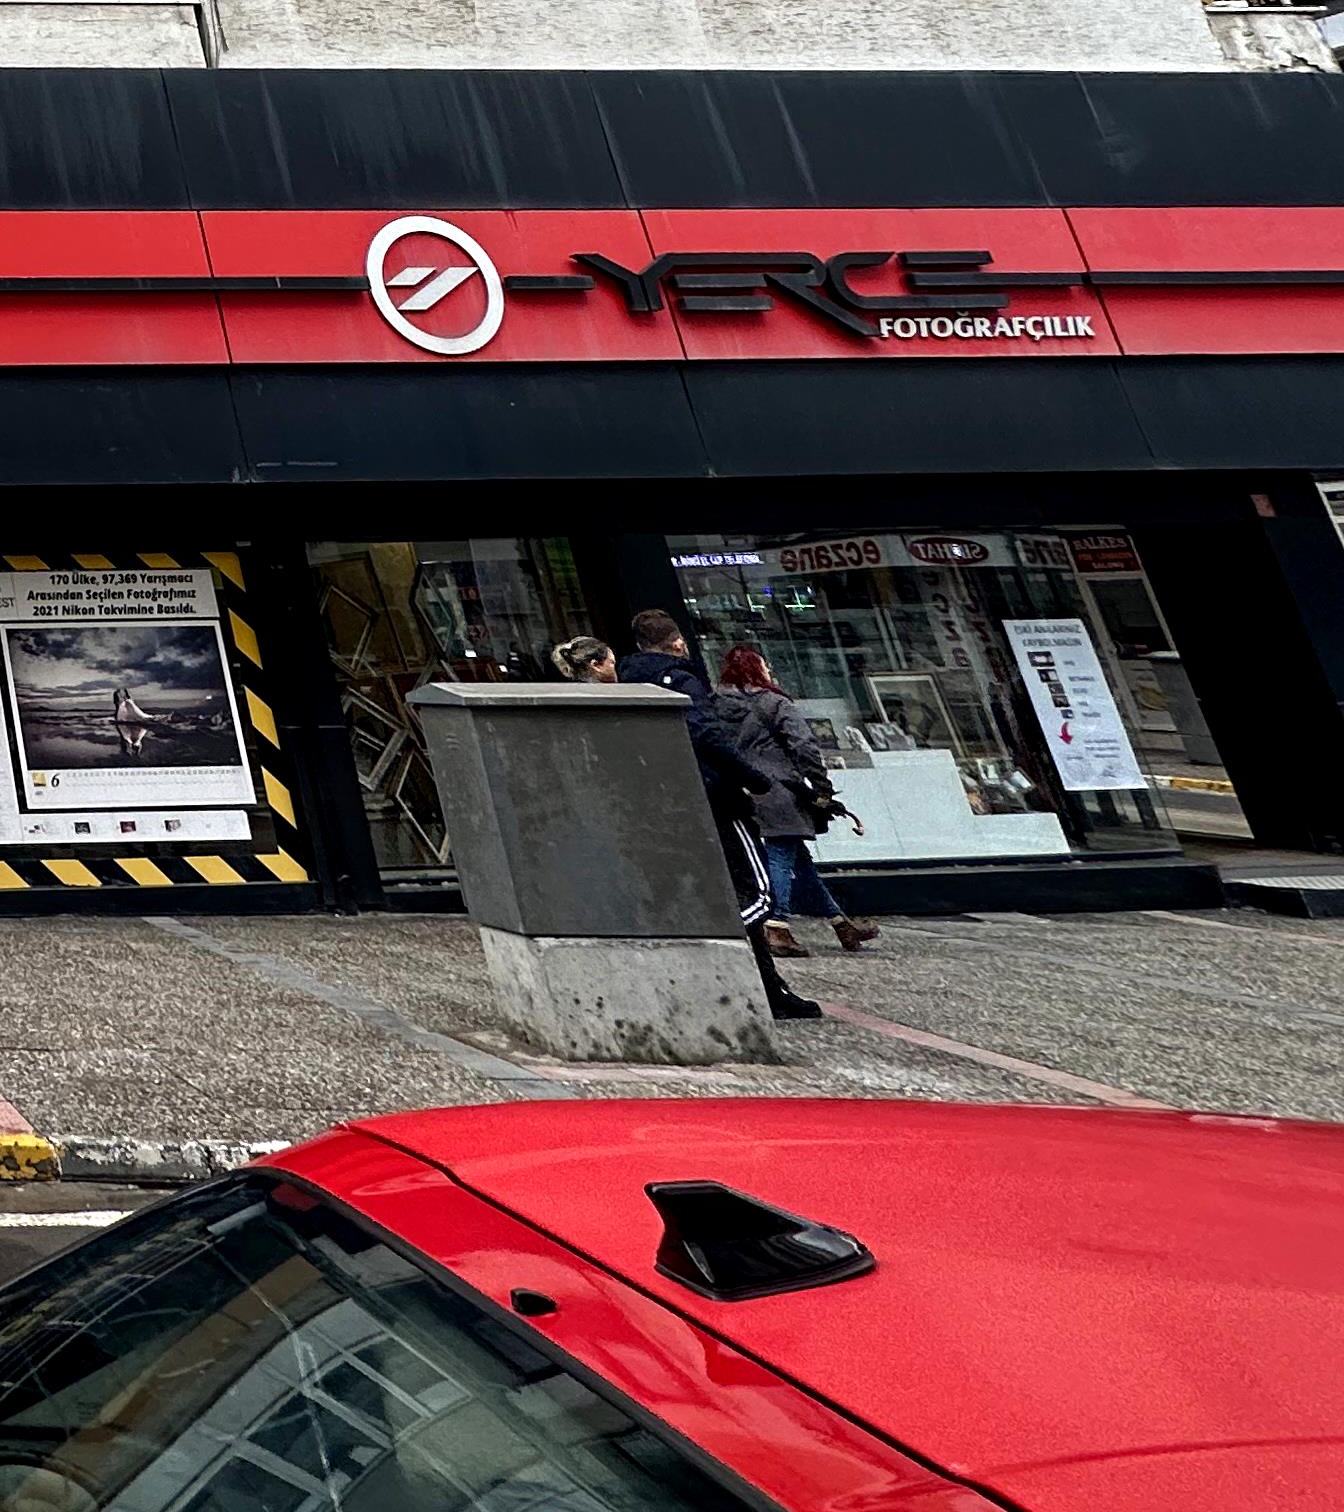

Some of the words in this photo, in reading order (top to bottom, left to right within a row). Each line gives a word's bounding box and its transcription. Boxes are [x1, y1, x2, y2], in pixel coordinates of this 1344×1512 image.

[879, 312, 1096, 342] FOTOĞRAFÇILIK
[49, 573, 69, 585] 170
[71, 571, 99, 586] Ülke,
[101, 573, 138, 586] 97,369
[139, 572, 193, 586] Yarışmacı
[27, 589, 83, 601] Arasından
[85, 588, 124, 603] Seçilen
[126, 587, 197, 602] Fotoğrafımız
[32, 604, 59, 616] 2021
[61, 603, 95, 616] Nikon
[96, 602, 154, 615] Takvimine
[50, 773, 61, 788] 6
